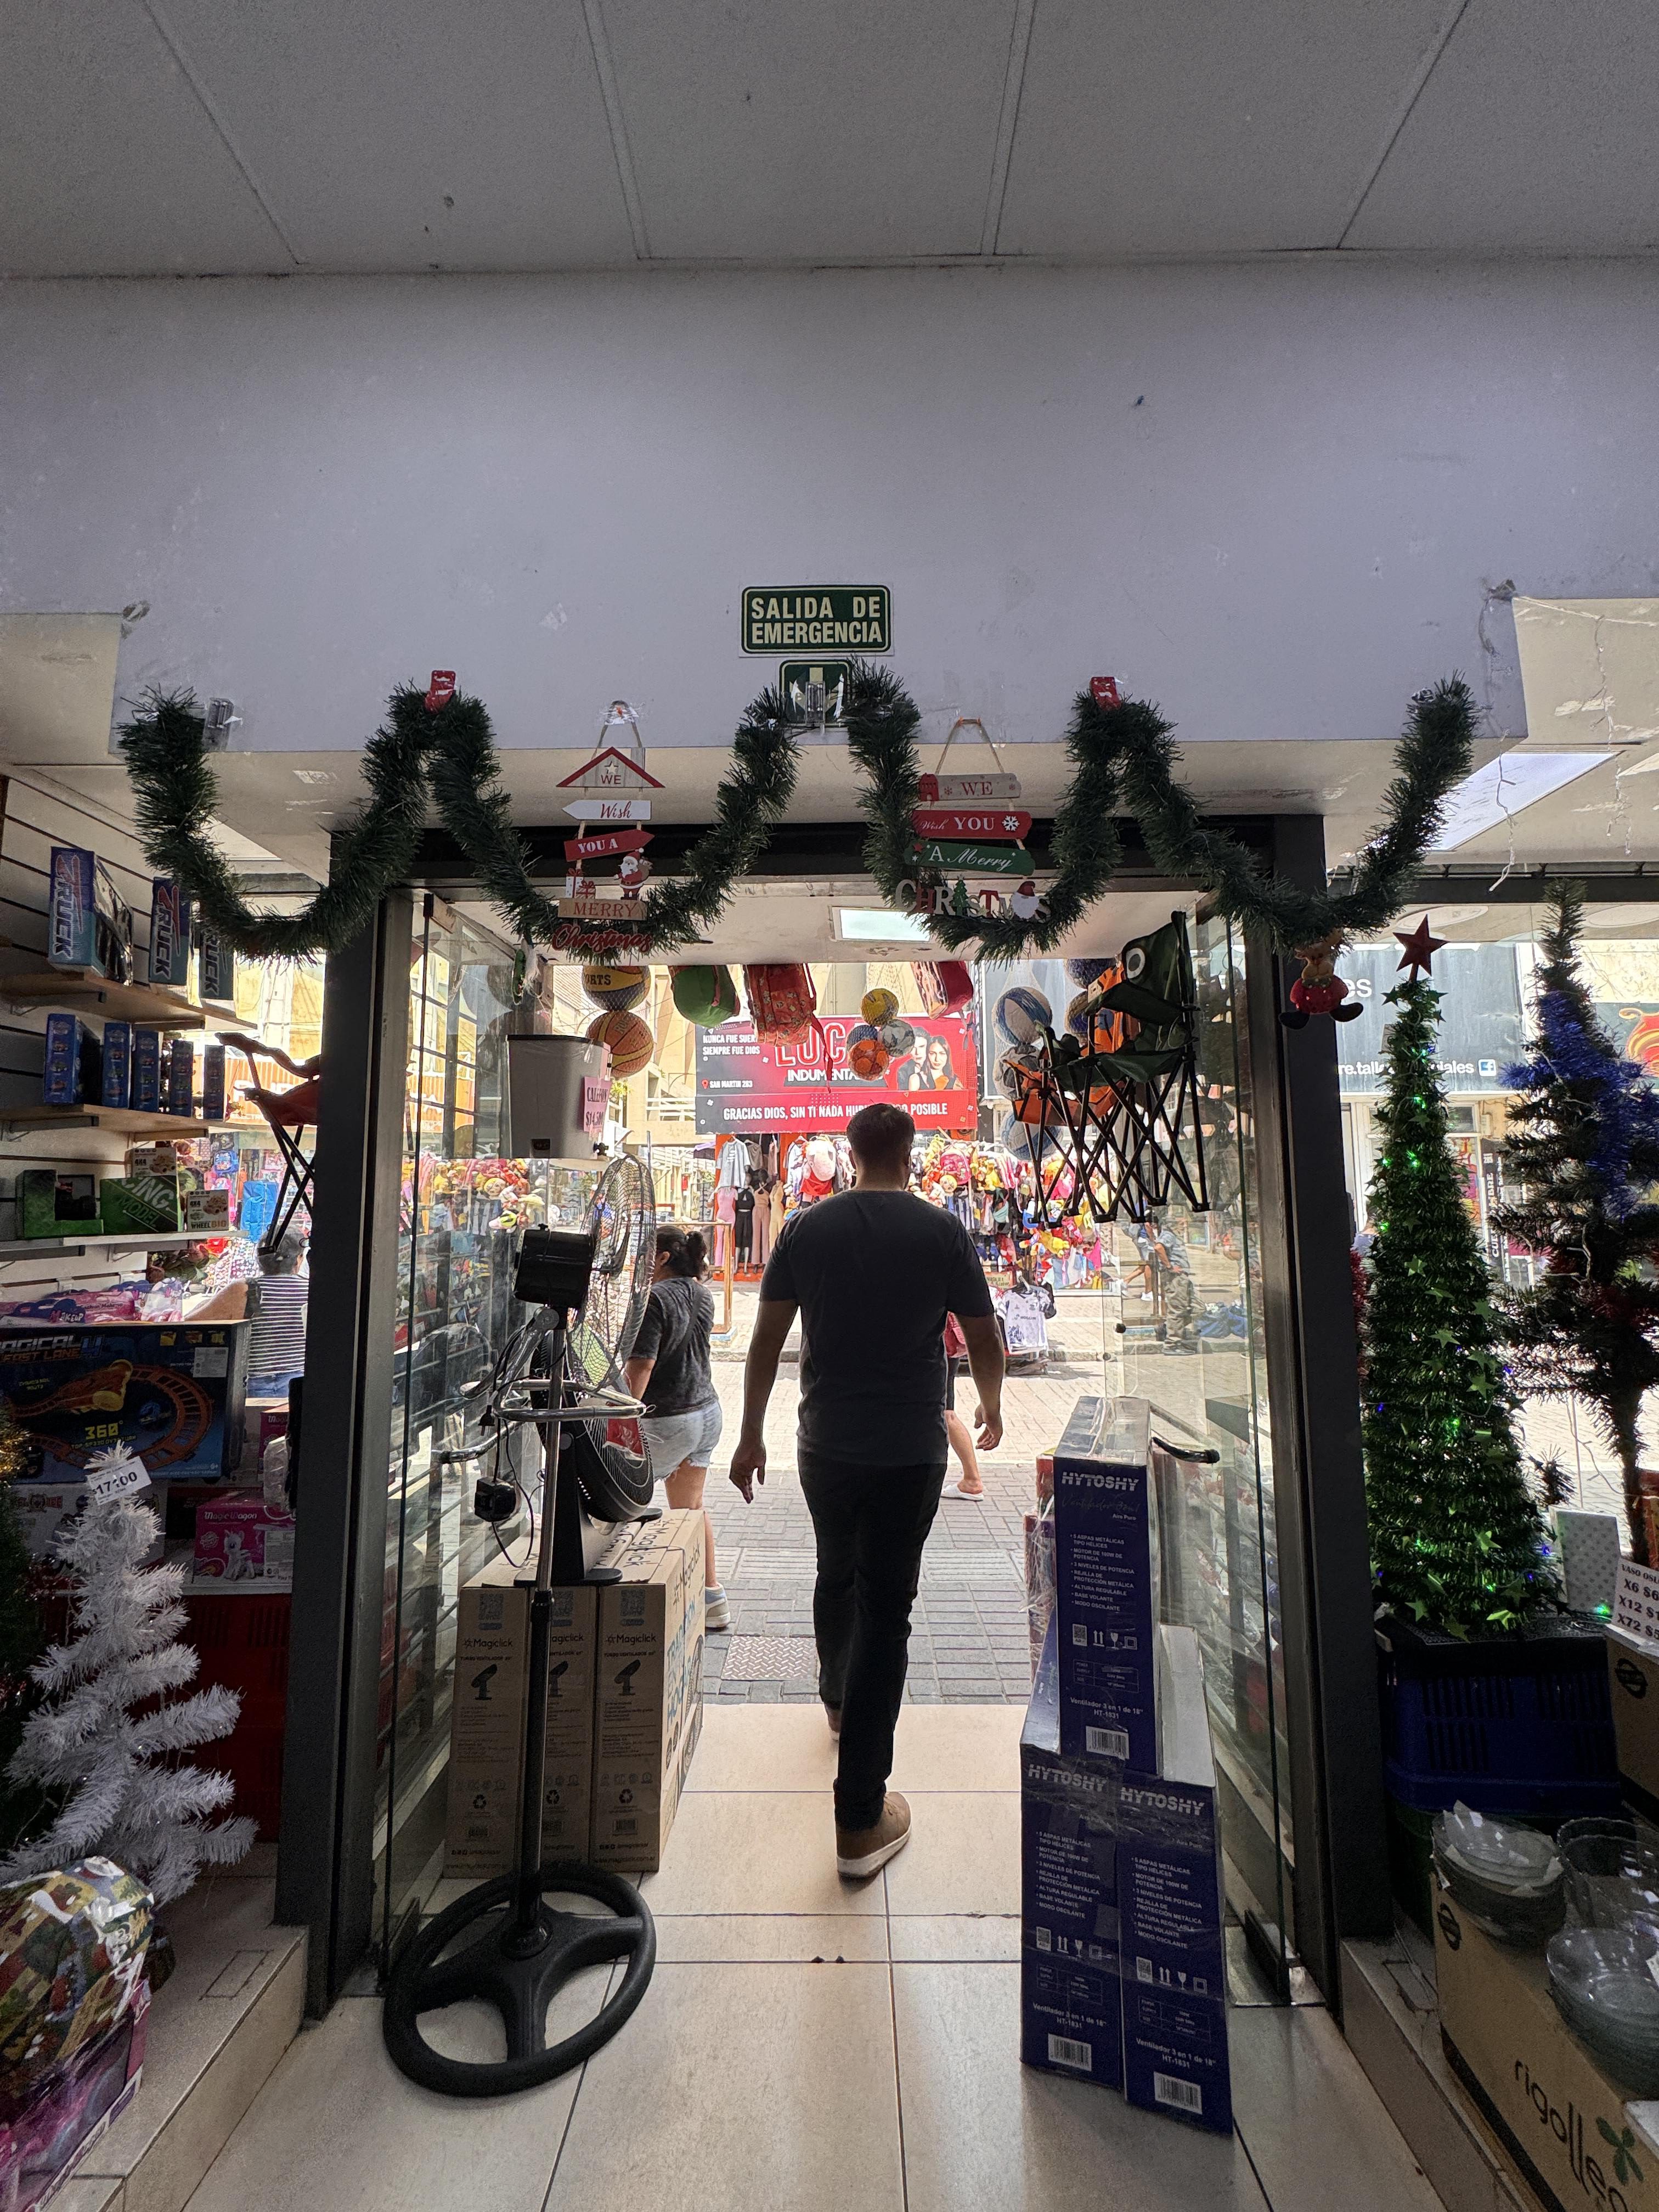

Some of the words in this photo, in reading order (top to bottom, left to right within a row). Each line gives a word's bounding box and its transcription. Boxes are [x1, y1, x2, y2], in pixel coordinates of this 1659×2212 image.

[752, 597, 833, 619] SALIDA
[853, 596, 881, 618] DE
[752, 622, 882, 644] EMERGENCIA
[601, 775, 621, 784] WE
[960, 781, 993, 795] WE
[600, 801, 631, 819] Wish
[922, 819, 950, 830] Wish
[953, 817, 995, 831] YOU
[578, 839, 605, 854] YOU
[609, 838, 618, 849] A
[929, 846, 944, 862] A
[947, 848, 1014, 872] Merry
[573, 902, 637, 917] MERRY
[552, 923, 653, 953] Christmas
[703, 1035, 725, 1043] NUNCA
[726, 1035, 738, 1043] FUE
[703, 1047, 730, 1055] SIEMPRE
[723, 1107, 763, 1120] GRACIAS
[764, 1107, 788, 1120] DIOS,
[791, 1107, 805, 1118] SIN
[808, 1106, 816, 1117] TI
[819, 1105, 843, 1117] NADA
[911, 1103, 947, 1115] POSIBLE
[191, 1221, 211, 1229] WHEEL
[211, 1220, 226, 1228] BIG
[0, 1335, 81, 1355] AGICAL
[1062, 1472, 1139, 1491] HYTOSHY
[204, 1511, 229, 1520] Magic
[1622, 1564, 1640, 1576] VASO
[1643, 1573, 1659, 1583] OSL
[1096, 1587, 1127, 1596] REGULABLE
[1624, 1578, 1639, 1592] X6
[1089, 1594, 1113, 1602] VOLANTE
[1619, 1595, 1641, 1613] X12
[1091, 1602, 1120, 1611] OSCILANTE
[1618, 1613, 1641, 1632] X72
[473, 1638, 513, 1649] Magiclick
[551, 1634, 584, 1645] agiclick
[617, 1633, 656, 1645] Magiclick
[1070, 1697, 1101, 1708] Ventilador
[1028, 1764, 1108, 1792] HYTOSHY
[1120, 1786, 1205, 1815] HYTOSHY
[1034, 2002, 1064, 2017] Ventilador
[1136, 2038, 1171, 2052] Ventilador
